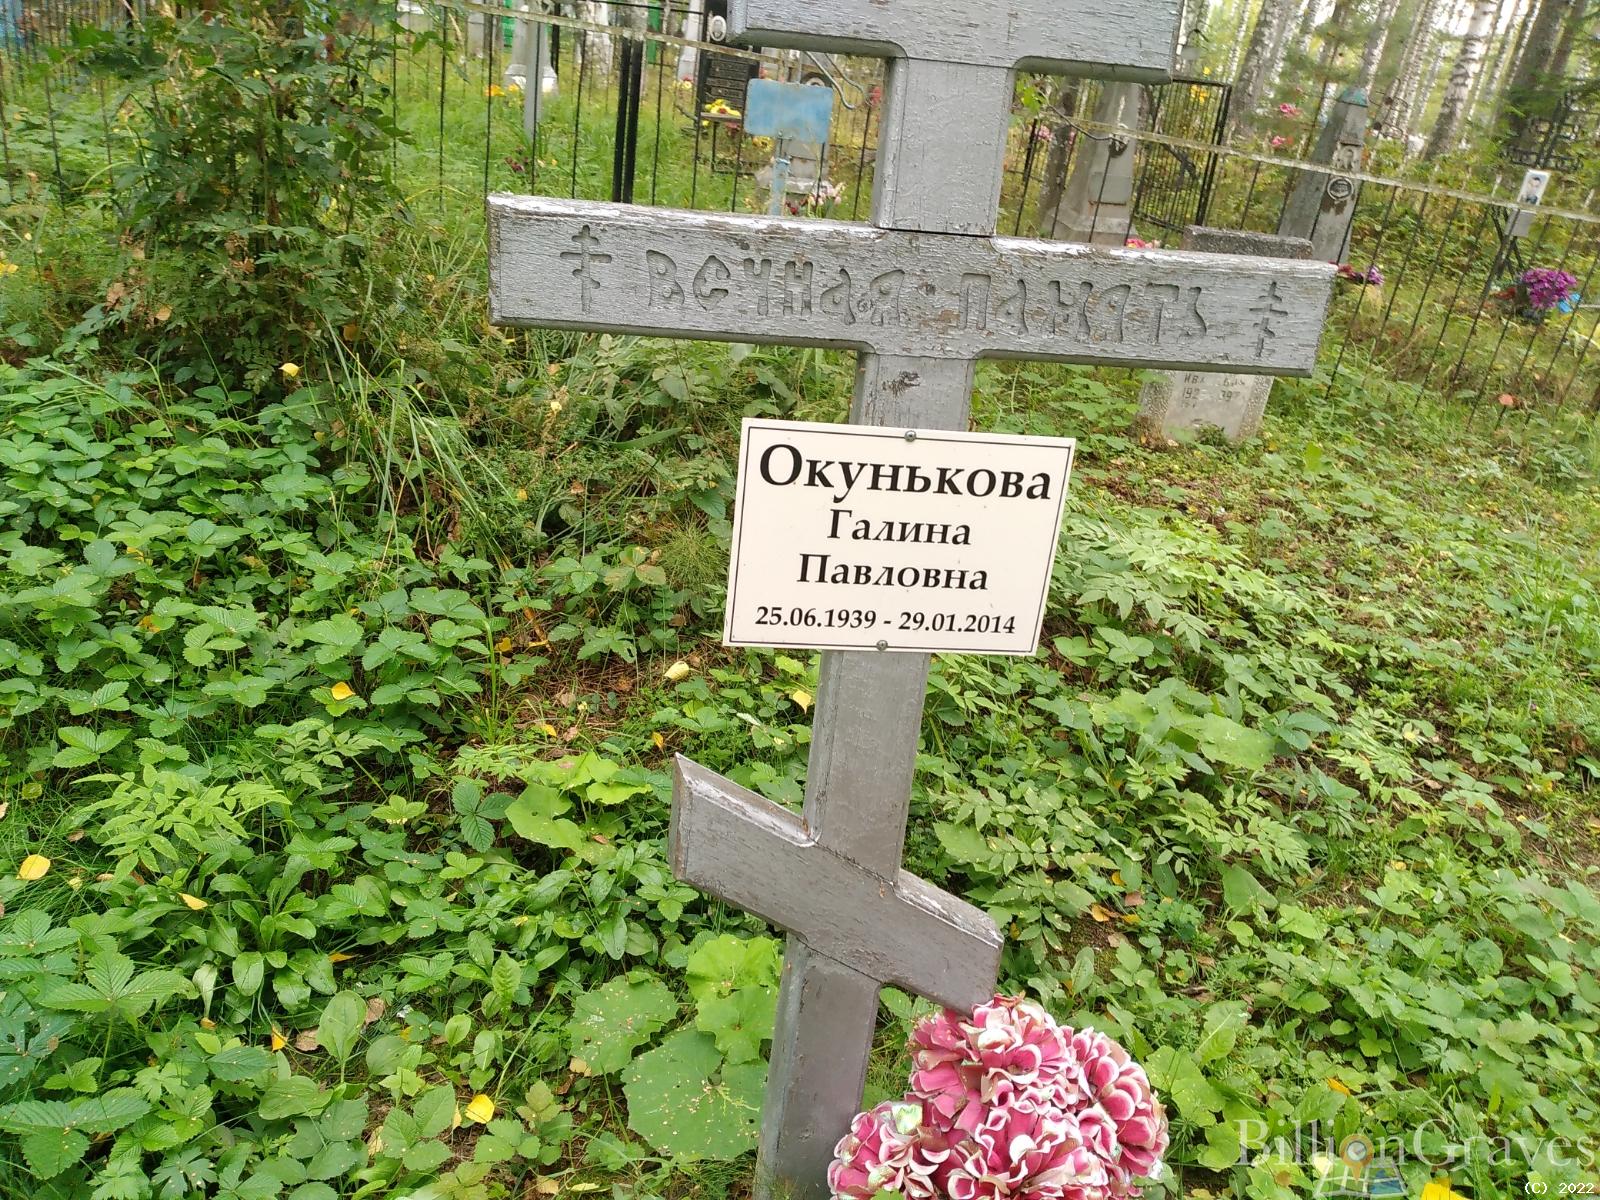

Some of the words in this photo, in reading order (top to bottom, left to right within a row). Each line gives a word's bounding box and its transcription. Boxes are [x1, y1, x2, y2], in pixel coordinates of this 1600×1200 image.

[759, 443, 1052, 504] Окунькова
[826, 508, 972, 546] Галина
[796, 553, 989, 591] Павловна
[754, 605, 877, 630] 25.06.1939
[898, 611, 1016, 634] 29.01.2014
